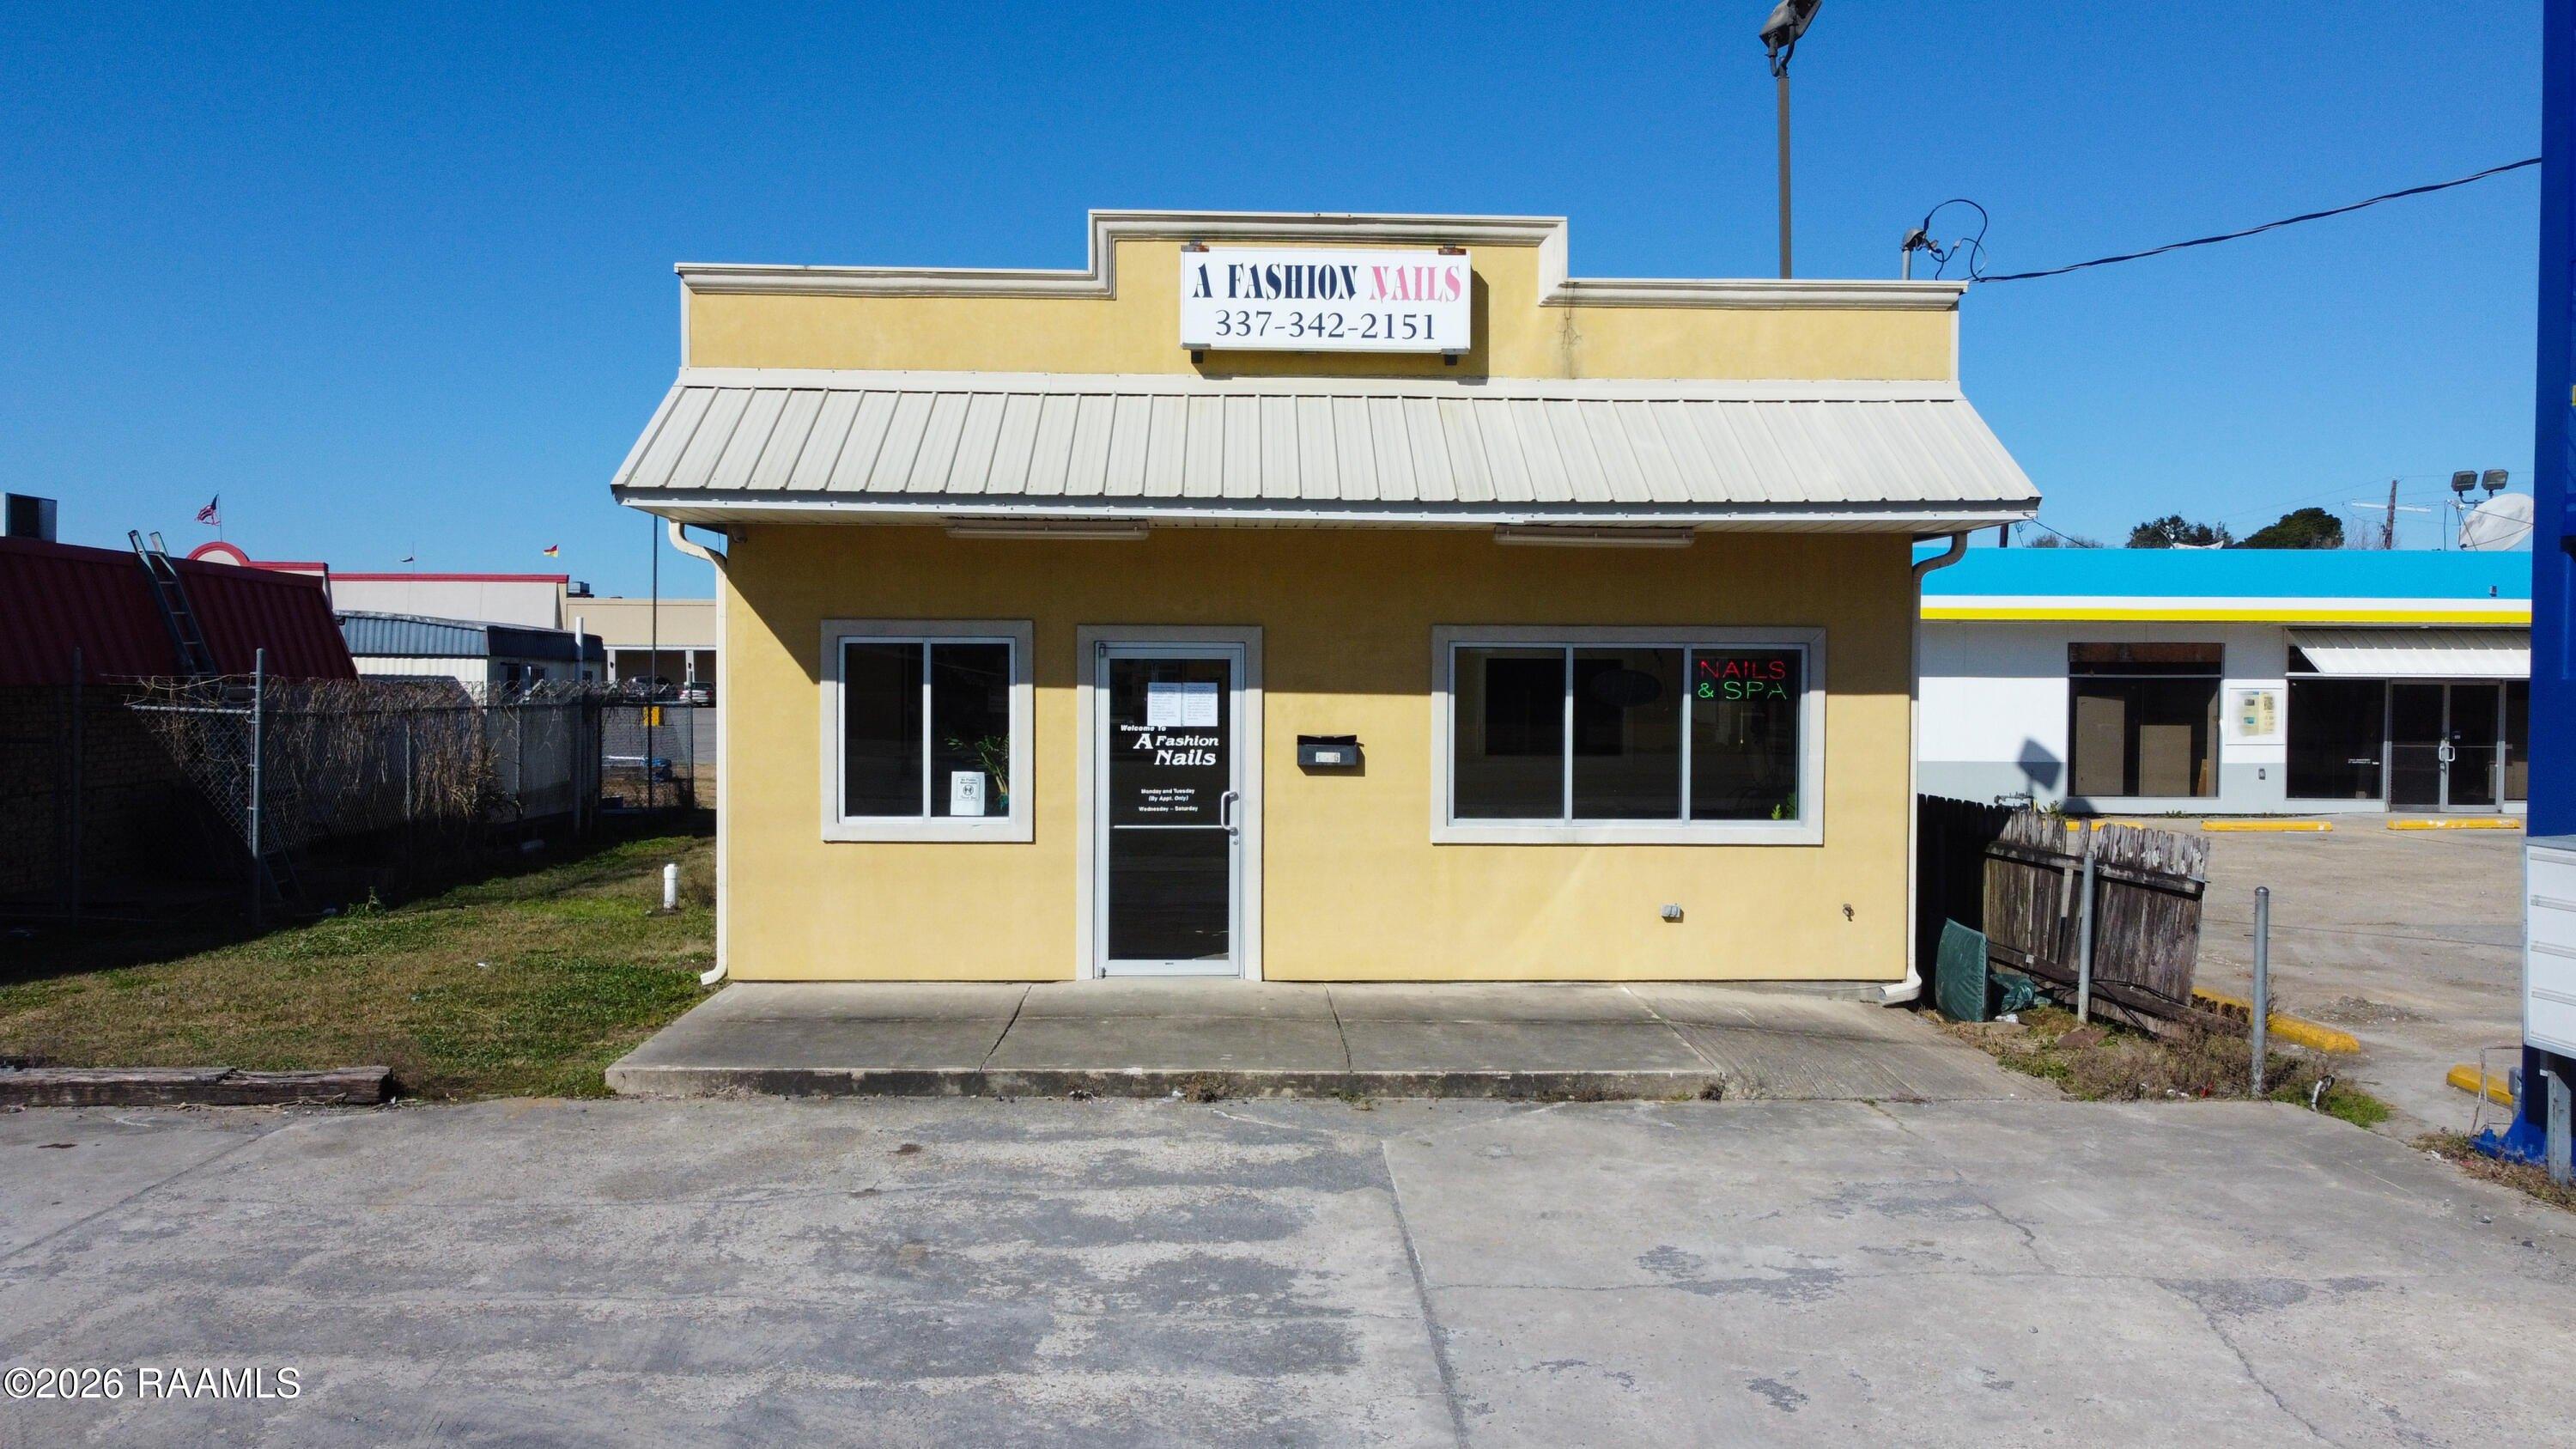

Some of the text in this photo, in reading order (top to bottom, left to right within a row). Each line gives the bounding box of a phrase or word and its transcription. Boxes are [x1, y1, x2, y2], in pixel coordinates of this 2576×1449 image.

[1192, 262, 1461, 303] A FASHION NAILS
[1215, 309, 1436, 340] 337-342-2151
[1698, 660, 1786, 679] NAILS
[1698, 681, 1788, 700] & SPA
[1133, 733, 1219, 750] A Fashion
[1154, 749, 1217, 765] Nails
